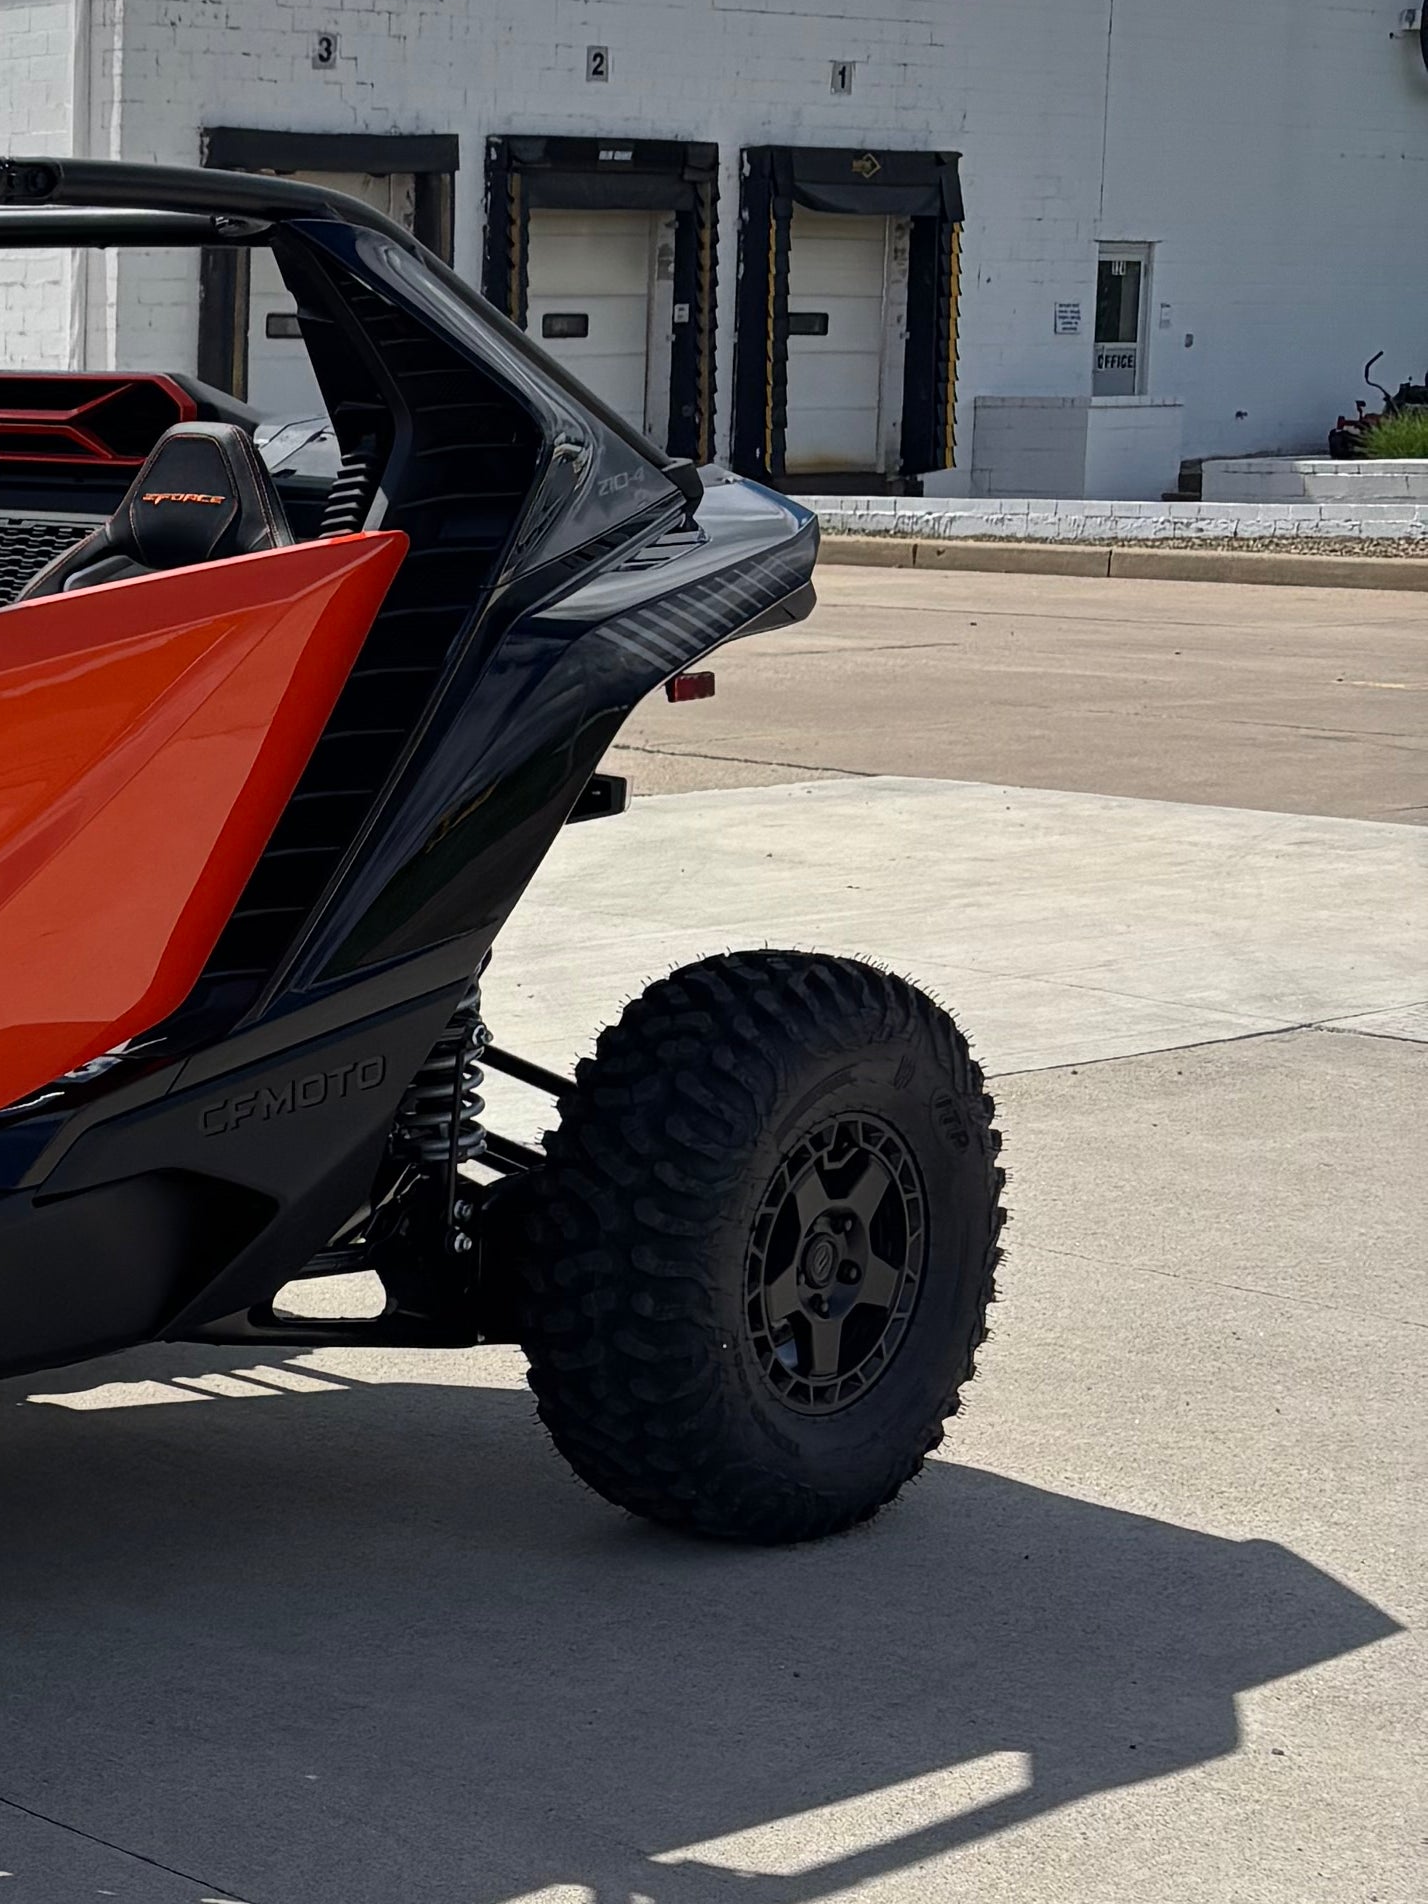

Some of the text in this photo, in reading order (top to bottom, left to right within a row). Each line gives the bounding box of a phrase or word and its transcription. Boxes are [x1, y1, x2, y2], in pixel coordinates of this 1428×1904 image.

[318, 36, 334, 64] 3
[591, 52, 606, 76] 2
[836, 64, 847, 90] 1
[1097, 354, 1134, 369] OFFICE
[141, 493, 227, 505] ZFORCE
[198, 1054, 387, 1137] CFMOTO
[934, 1094, 970, 1153] ITP
